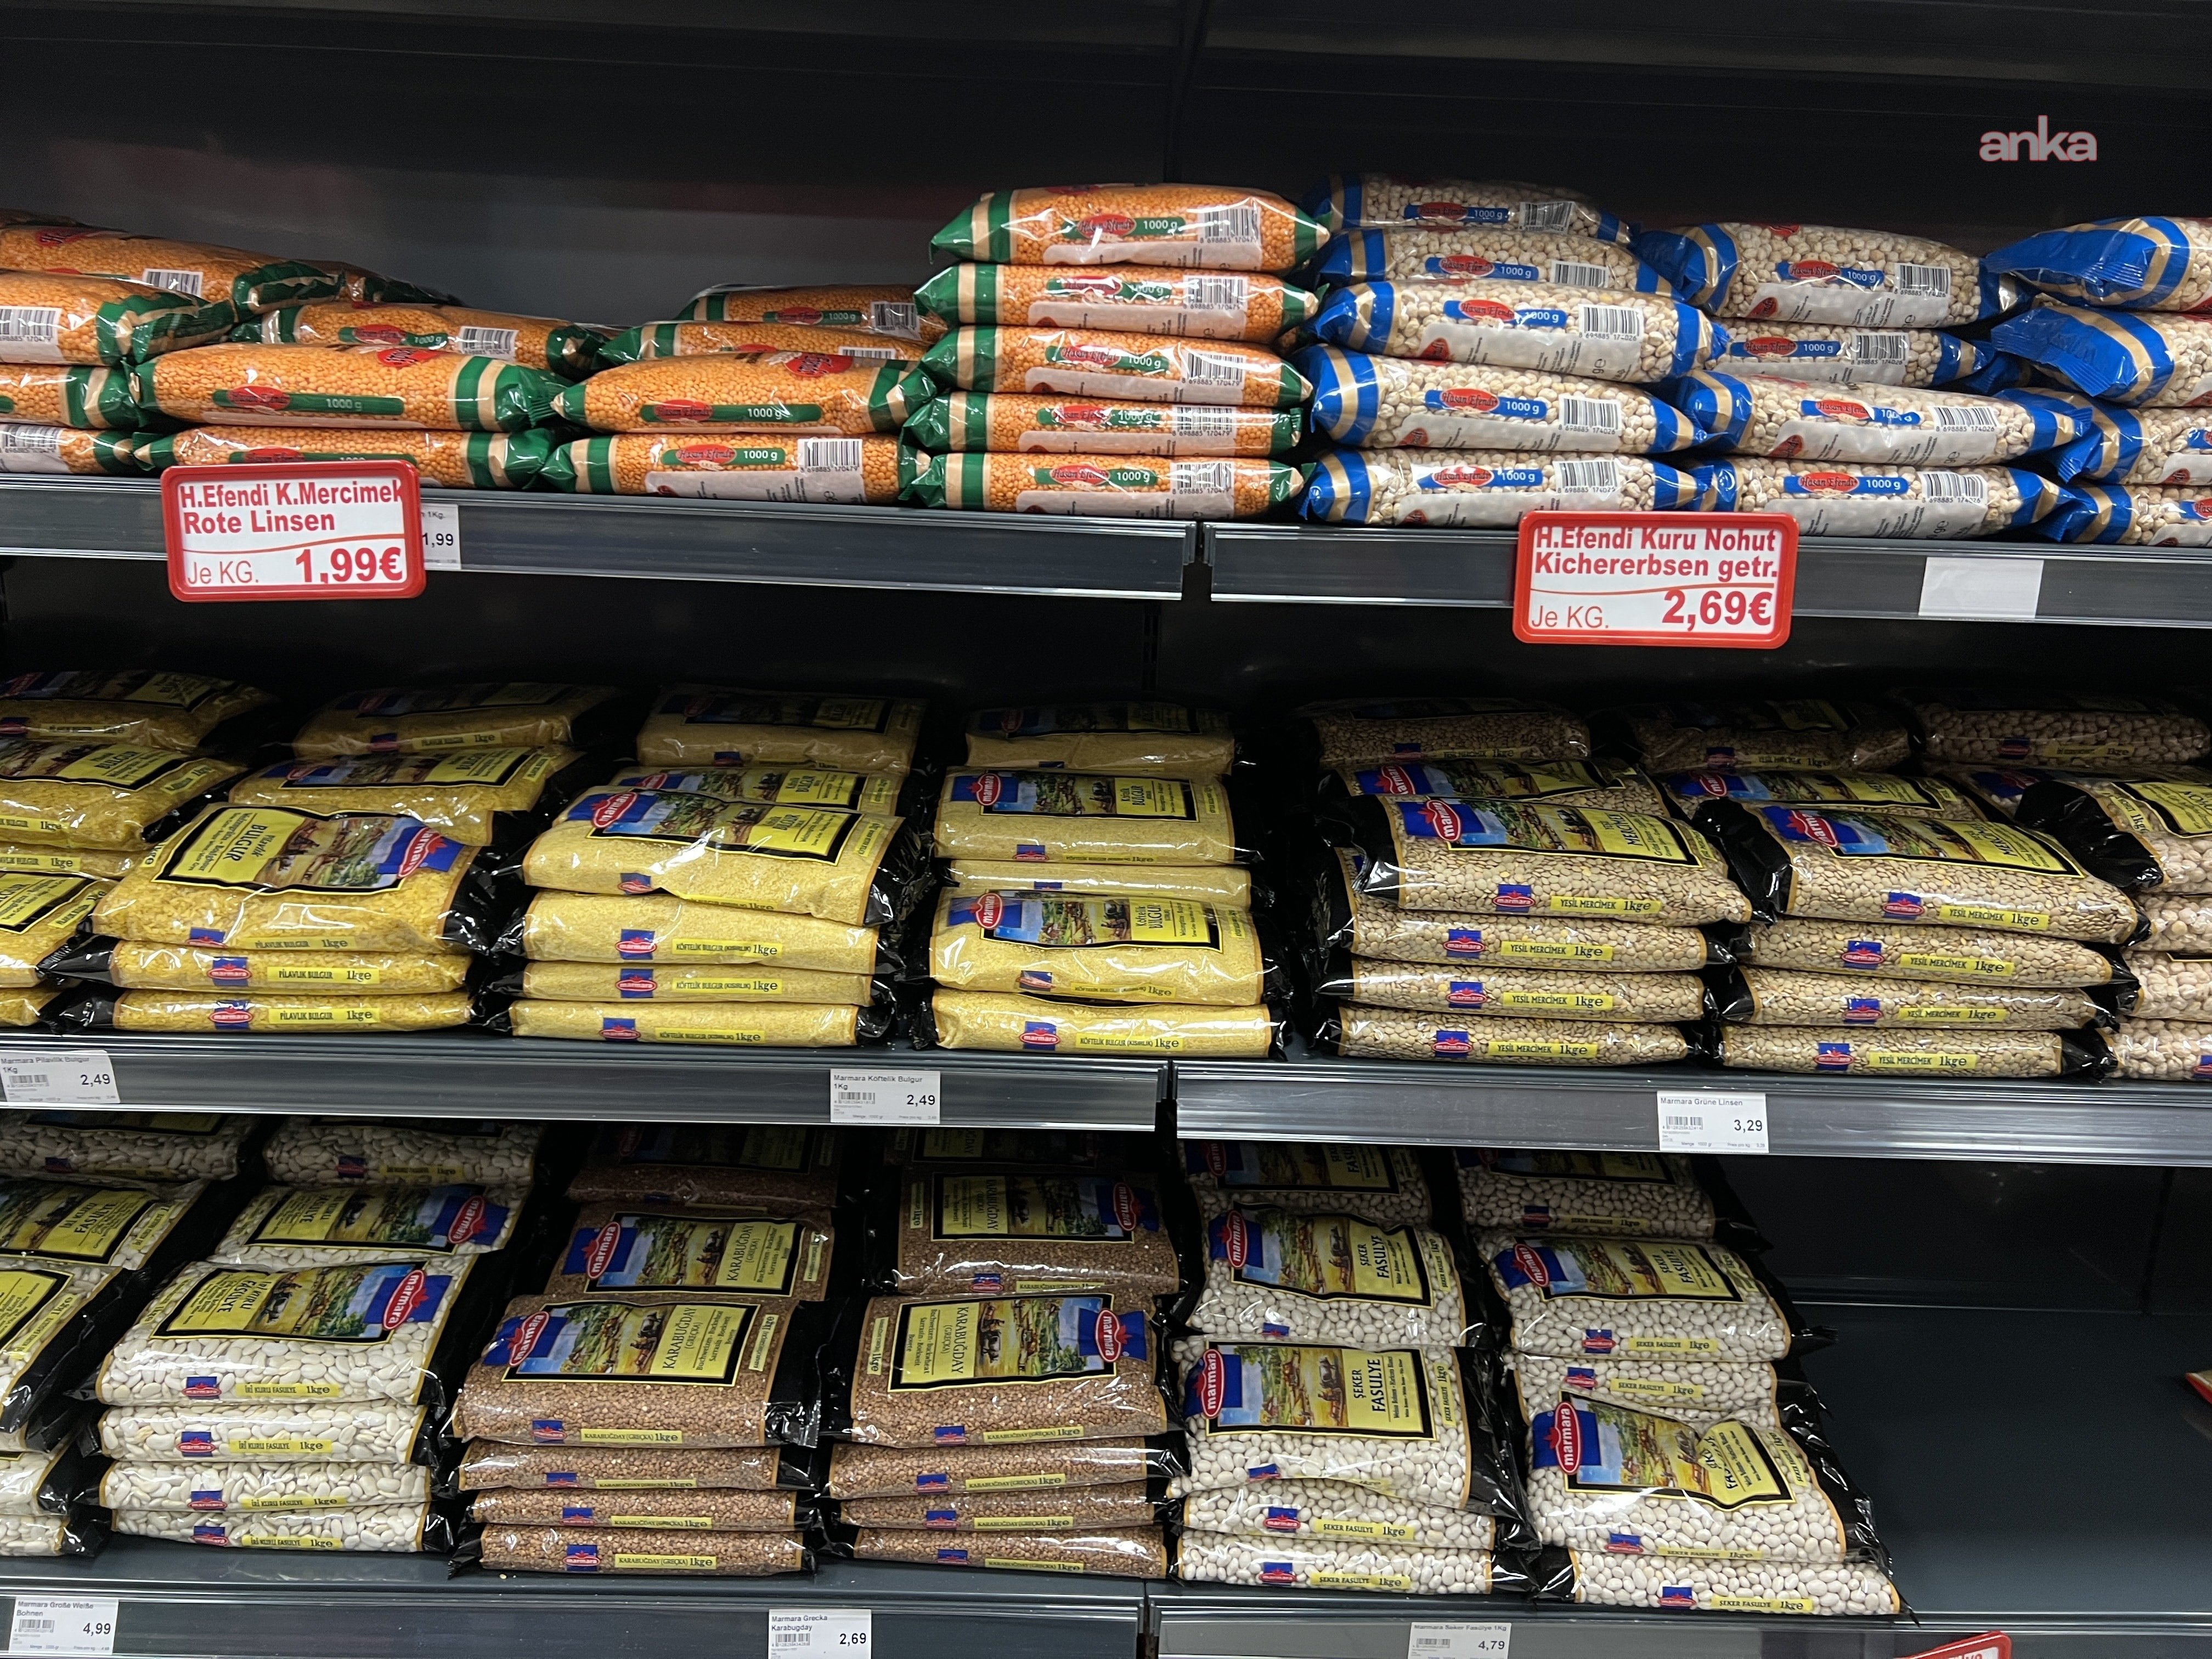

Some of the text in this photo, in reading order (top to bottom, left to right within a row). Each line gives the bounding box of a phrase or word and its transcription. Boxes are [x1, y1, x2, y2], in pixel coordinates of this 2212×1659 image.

[1501, 266, 1523, 275] 1000
[1525, 269, 1531, 279] g
[1848, 271, 1876, 284] 1000 g
[1803, 343, 1826, 352] 1000
[1827, 345, 1833, 354] g
[1128, 356, 1161, 369] 1000 g
[325, 398, 363, 411] 1000 g
[1506, 400, 1530, 411] 1000
[1532, 404, 1539, 414] g
[743, 450, 769, 459] 1000
[771, 452, 778, 461] g
[1116, 472, 1150, 483] 1000 g
[1801, 477, 1826, 487] Hasan
[1866, 479, 1891, 489] 1000
[1893, 481, 1900, 490] g
[180, 483, 269, 507] H.Efendi
[184, 510, 335, 534] Rote Linsen
[422, 532, 454, 548] 1,99
[1536, 526, 1777, 552] H.Efendi Kuru Nohut
[187, 547, 404, 585] Je KG. 1,99€
[1536, 552, 1778, 583] Kichererbsen getr.
[1532, 590, 1773, 631] Je KG. 2,69€
[223, 823, 269, 862] BULGUR
[983, 895, 997, 924] marmara
[1886, 905, 1921, 913] marmara
[1844, 954, 1881, 962] marmara
[80, 1074, 110, 1087] 2,49
[906, 1094, 935, 1107] 2,49
[1734, 1119, 1763, 1133] 3,29
[591, 1225, 617, 1273] marmara
[1232, 1215, 1243, 1262] marmara
[726, 1224, 754, 1281] KARABUĞDAY
[1372, 1235, 1390, 1278] FASULYE
[387, 1273, 421, 1325] marmara
[514, 1315, 546, 1362] marmara
[662, 1306, 698, 1370] KARABUĞDAY
[951, 1306, 969, 1375] KARABUĞDAY
[1101, 1316, 1115, 1357] marmara
[1209, 1353, 1217, 1410] marmara
[1353, 1369, 1363, 1399] ŞEKER
[1372, 1358, 1386, 1413] FASULYE
[1562, 1408, 1573, 1466] marmara
[83, 1622, 111, 1637] 4,99
[839, 1633, 867, 1646] 2,69
[1478, 1640, 1505, 1651] 4,79
